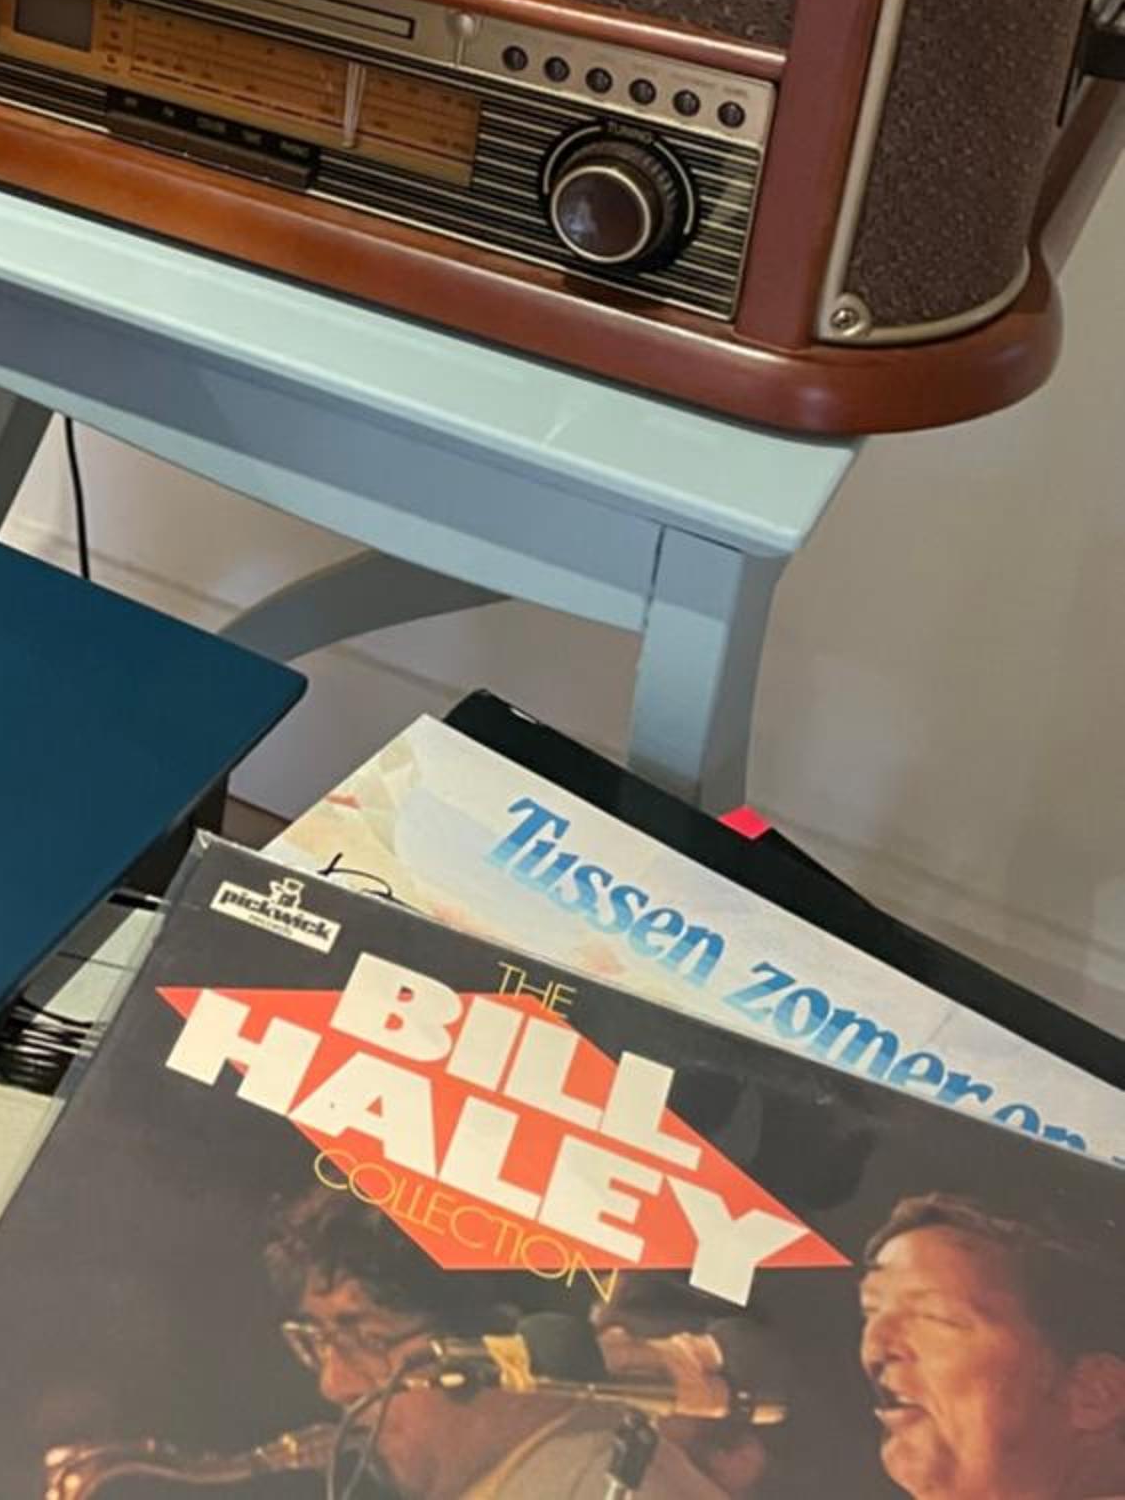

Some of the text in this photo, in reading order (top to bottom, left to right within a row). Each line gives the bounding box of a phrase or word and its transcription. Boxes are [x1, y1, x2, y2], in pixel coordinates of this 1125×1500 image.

[218, 888, 331, 941] pickwick
[484, 796, 994, 1106] Tussen zomer
[497, 960, 576, 1022] THE
[164, 987, 812, 1308] HALEY
[328, 951, 703, 1171] BILL
[313, 1148, 620, 1304] COLLECTION
